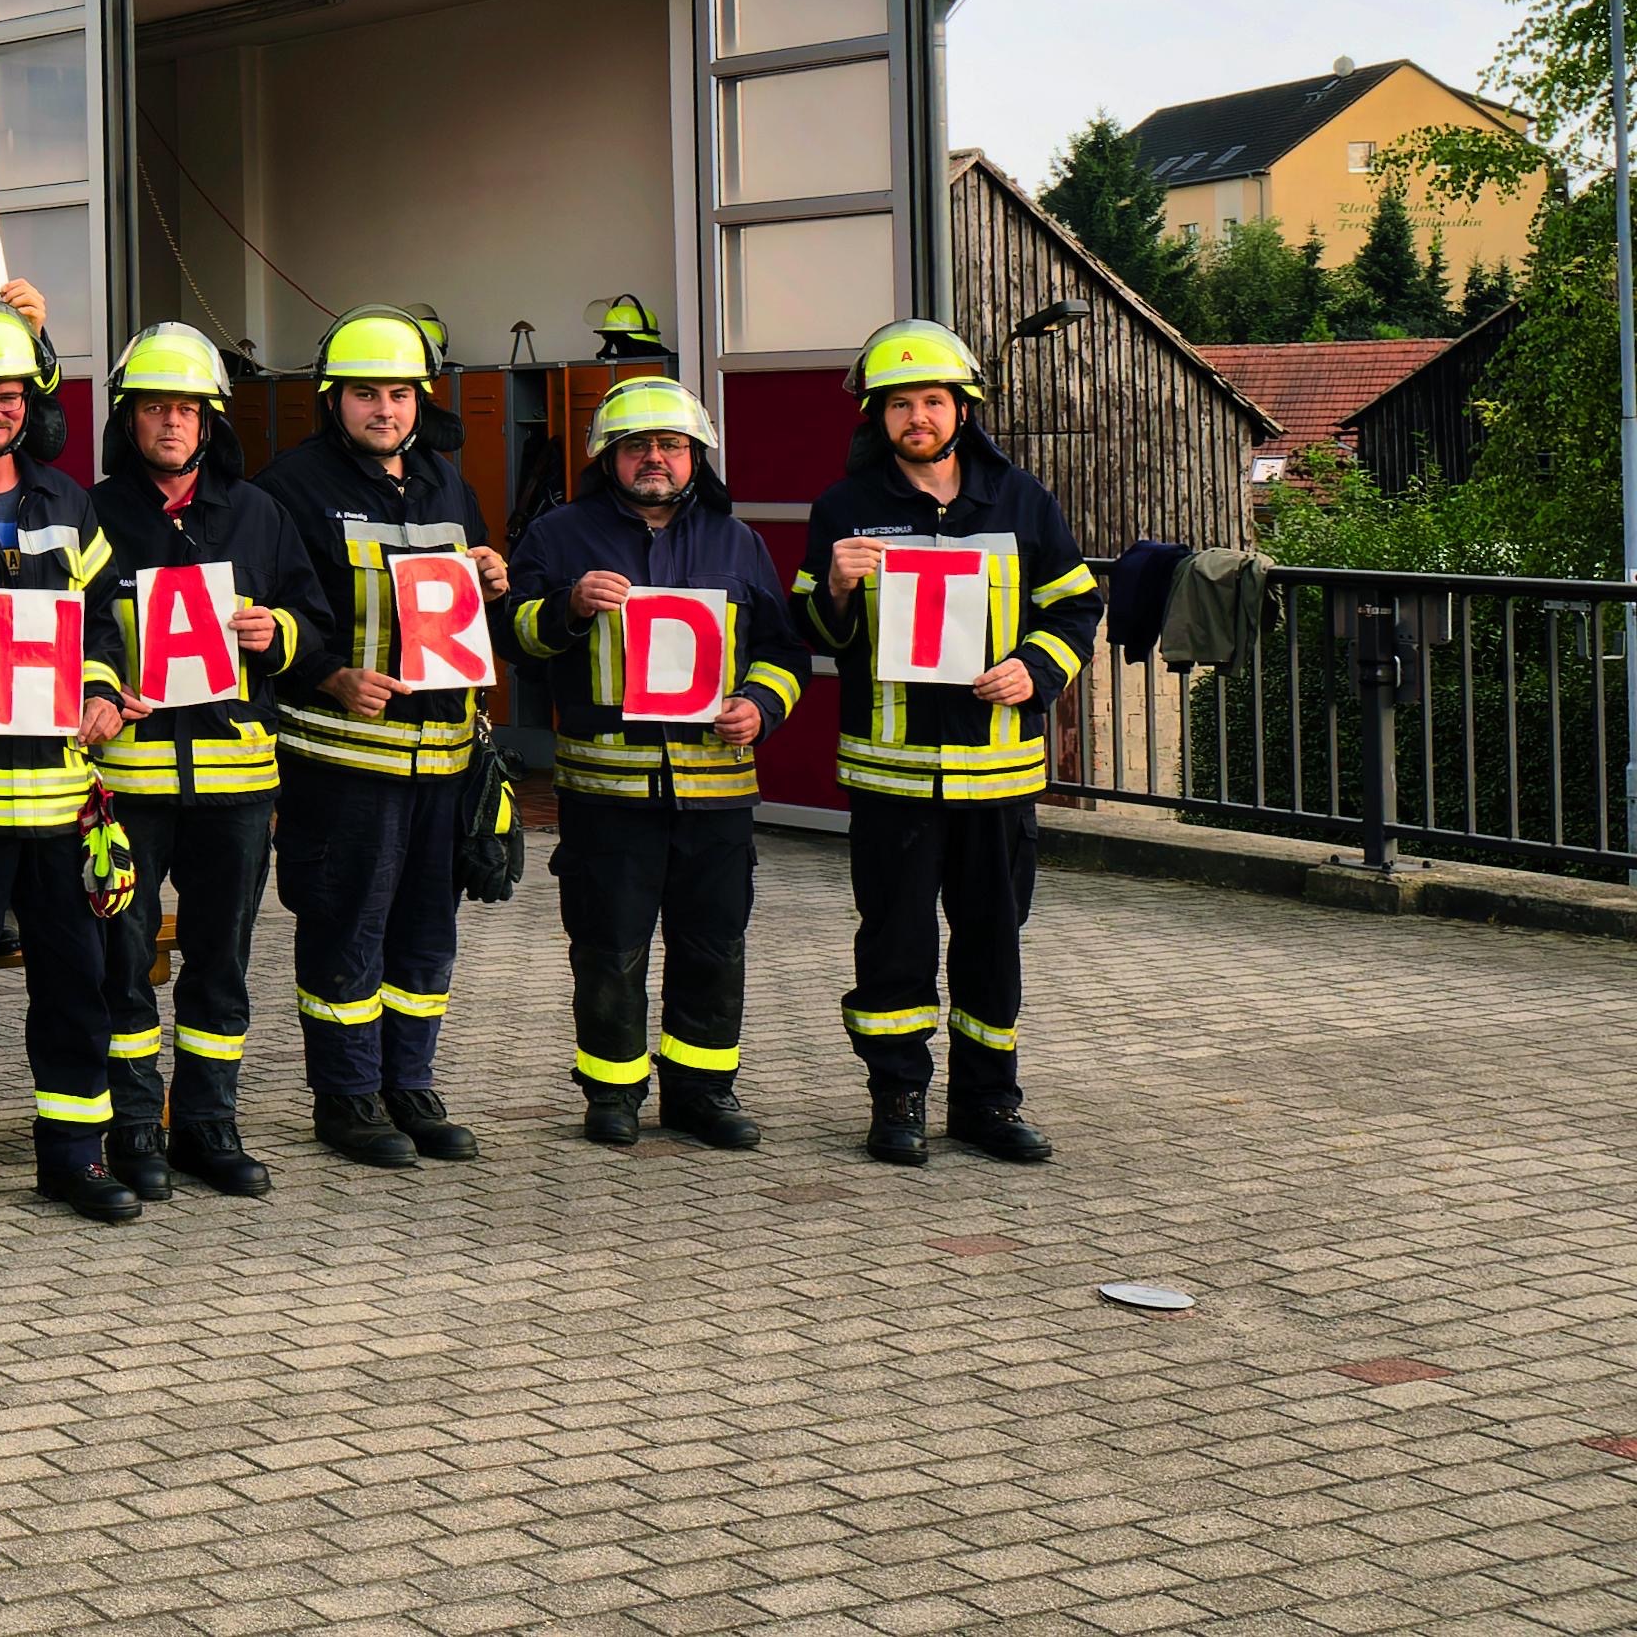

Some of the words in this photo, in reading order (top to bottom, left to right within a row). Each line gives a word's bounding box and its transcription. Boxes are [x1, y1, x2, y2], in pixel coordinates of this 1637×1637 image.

[900, 350, 914, 363] A
[140, 564, 237, 702] A
[395, 557, 487, 682] R
[623, 594, 723, 716] D
[884, 548, 982, 669] T
